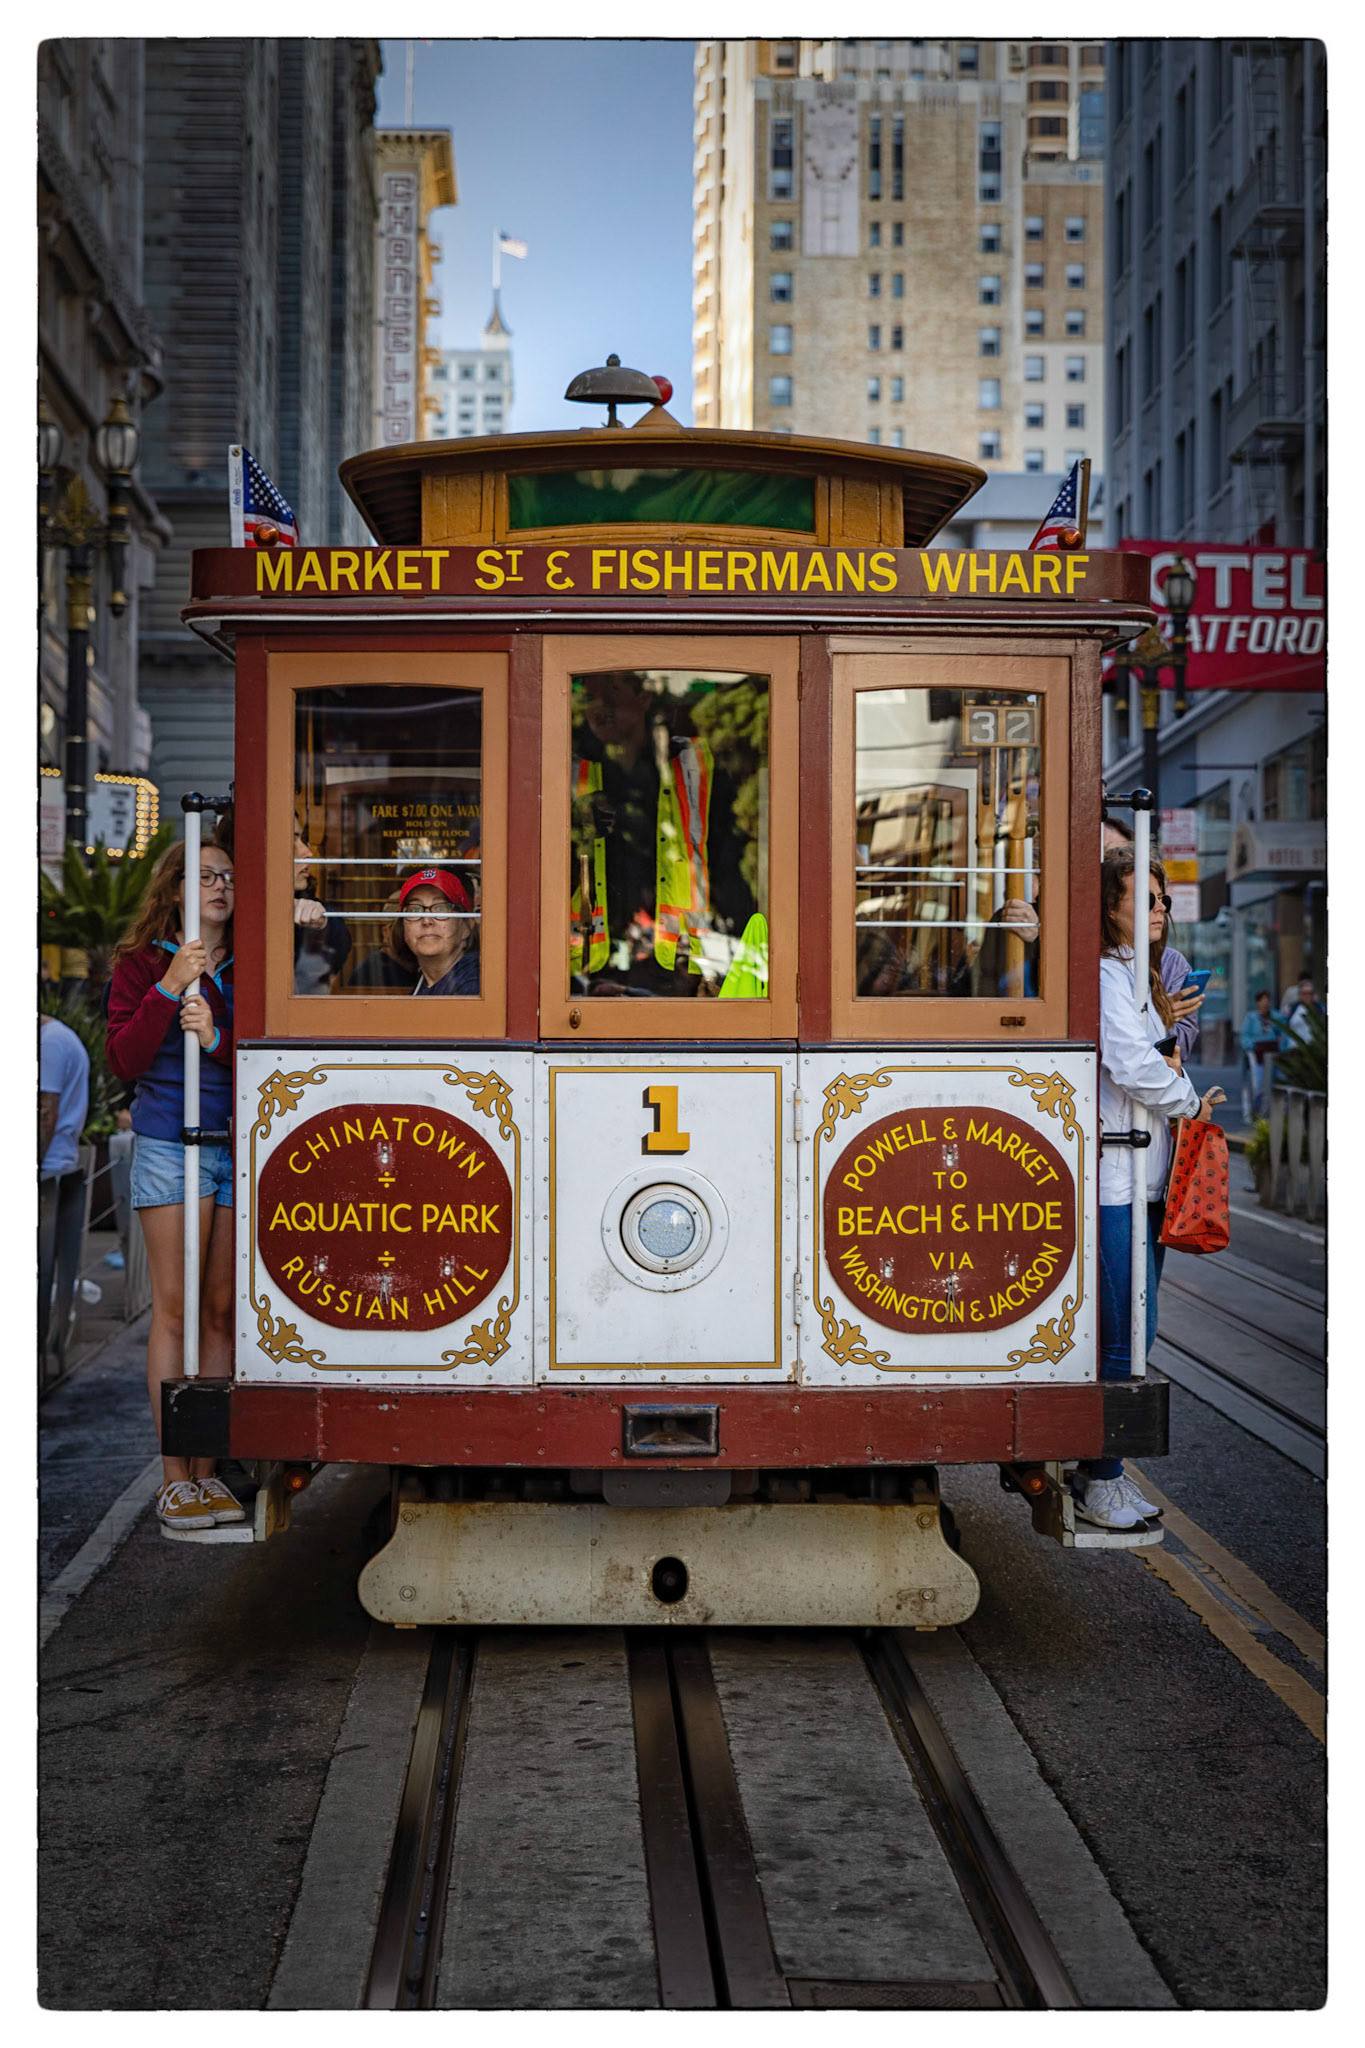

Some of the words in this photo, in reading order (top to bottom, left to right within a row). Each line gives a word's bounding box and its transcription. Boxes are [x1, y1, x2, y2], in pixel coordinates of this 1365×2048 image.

[256, 550, 450, 592] MARKET
[474, 549, 523, 590] ST
[546, 551, 575, 589] &
[592, 549, 898, 592] FISHERMANS
[920, 553, 1090, 594] WHARF
[972, 711, 1030, 743] 32
[372, 805, 398, 817] FARE
[402, 804, 427, 818] $7.00
[430, 805, 453, 817] ONE
[457, 805, 480, 817] WAY
[641, 1085, 690, 1155] 1
[289, 1117, 486, 1179] CHINATOWN
[843, 1120, 936, 1192] POWELL
[943, 1118, 958, 1140] &
[966, 1118, 1059, 1186] MARKET
[932, 1171, 967, 1189] TO
[269, 1202, 412, 1232] AQUATIC
[422, 1204, 500, 1233] PARK
[838, 1205, 942, 1236] BEACH
[951, 1204, 970, 1232] &
[977, 1201, 1063, 1232] HYDE
[929, 1252, 974, 1271] VIA
[281, 1256, 409, 1320] RUSSIAN
[423, 1265, 489, 1315] HILL
[839, 1245, 965, 1323] WASHINGTON
[970, 1300, 985, 1322] &
[988, 1242, 1063, 1318] JACKSON
